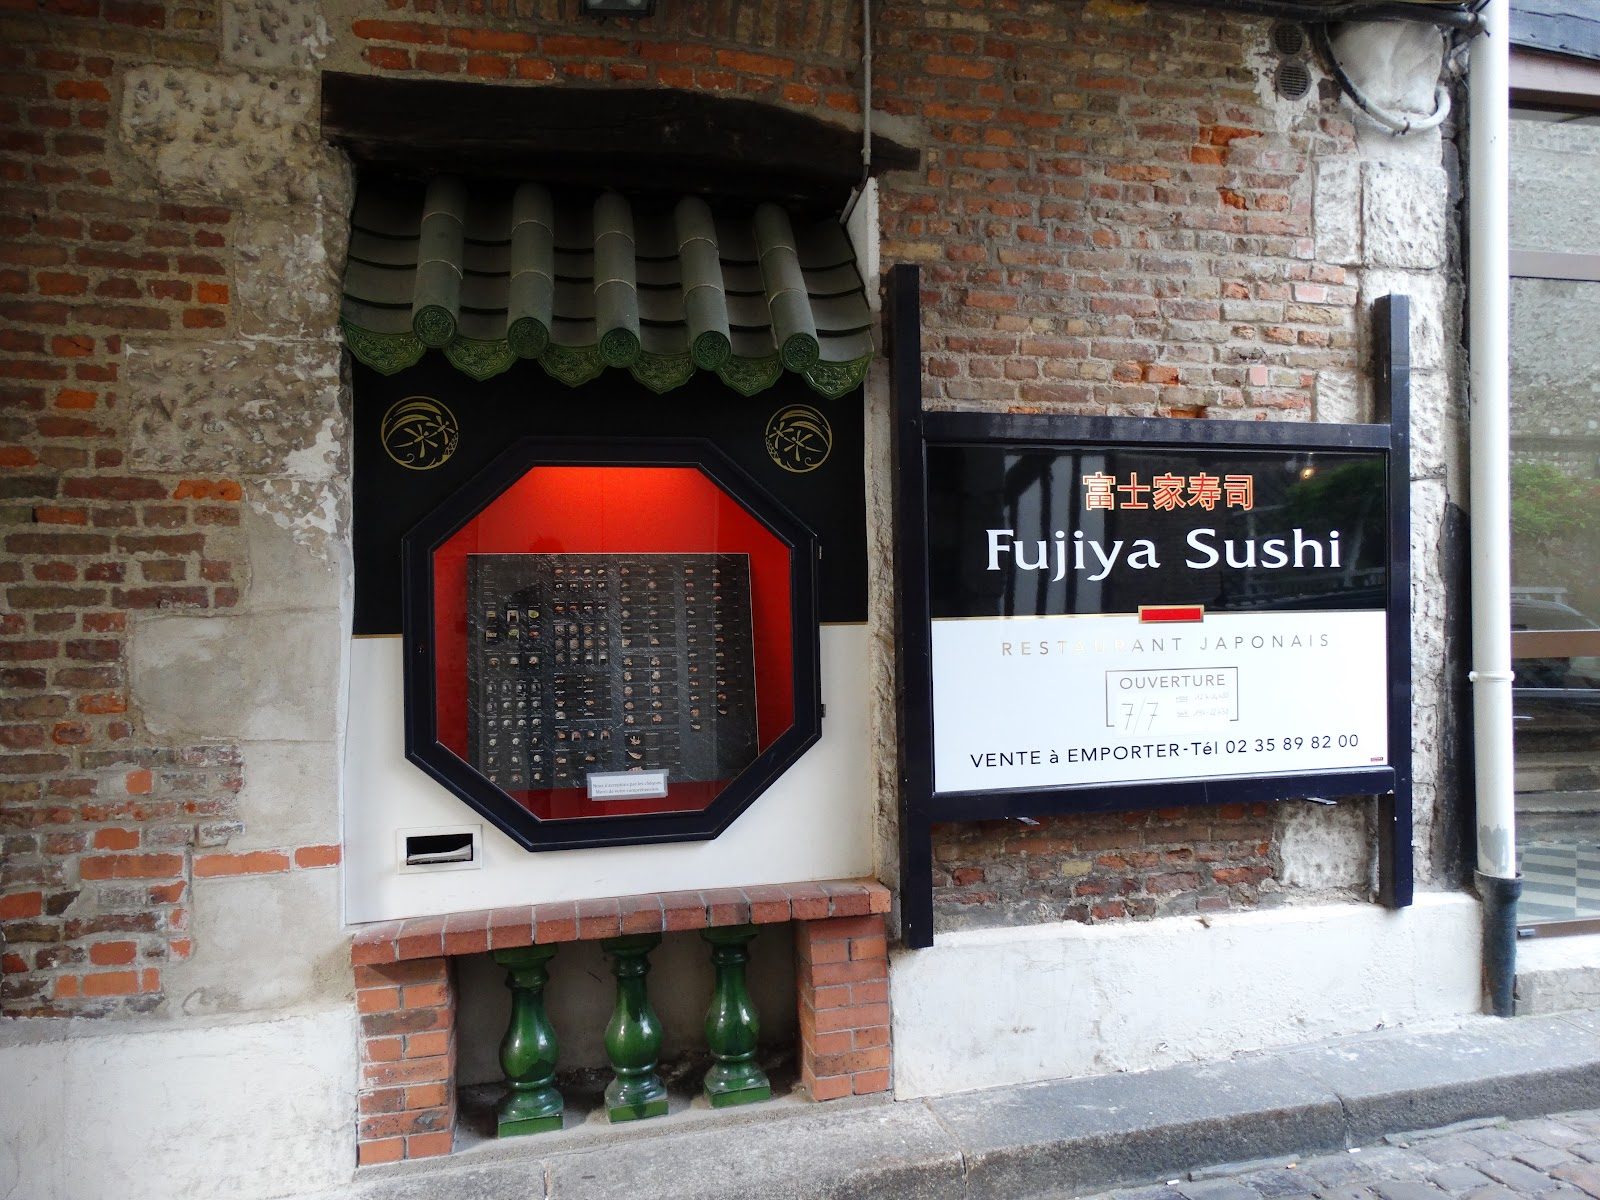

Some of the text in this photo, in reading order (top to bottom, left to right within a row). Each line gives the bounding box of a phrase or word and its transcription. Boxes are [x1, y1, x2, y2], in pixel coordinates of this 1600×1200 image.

[1083, 472, 1253, 511] 富士家寿司
[985, 528, 1342, 581] Fujiya Sushi
[1200, 633, 1329, 651] JAPONAIS
[1119, 674, 1226, 690] OUVERTURE
[1120, 696, 1160, 735] 7/7
[970, 750, 1041, 768] VENTE
[1049, 749, 1059, 763] à
[1225, 739, 1247, 754] 02
[1254, 738, 1275, 752] 35
[1283, 736, 1304, 751] 89
[1311, 735, 1332, 750] 82
[1338, 734, 1359, 748] 00
